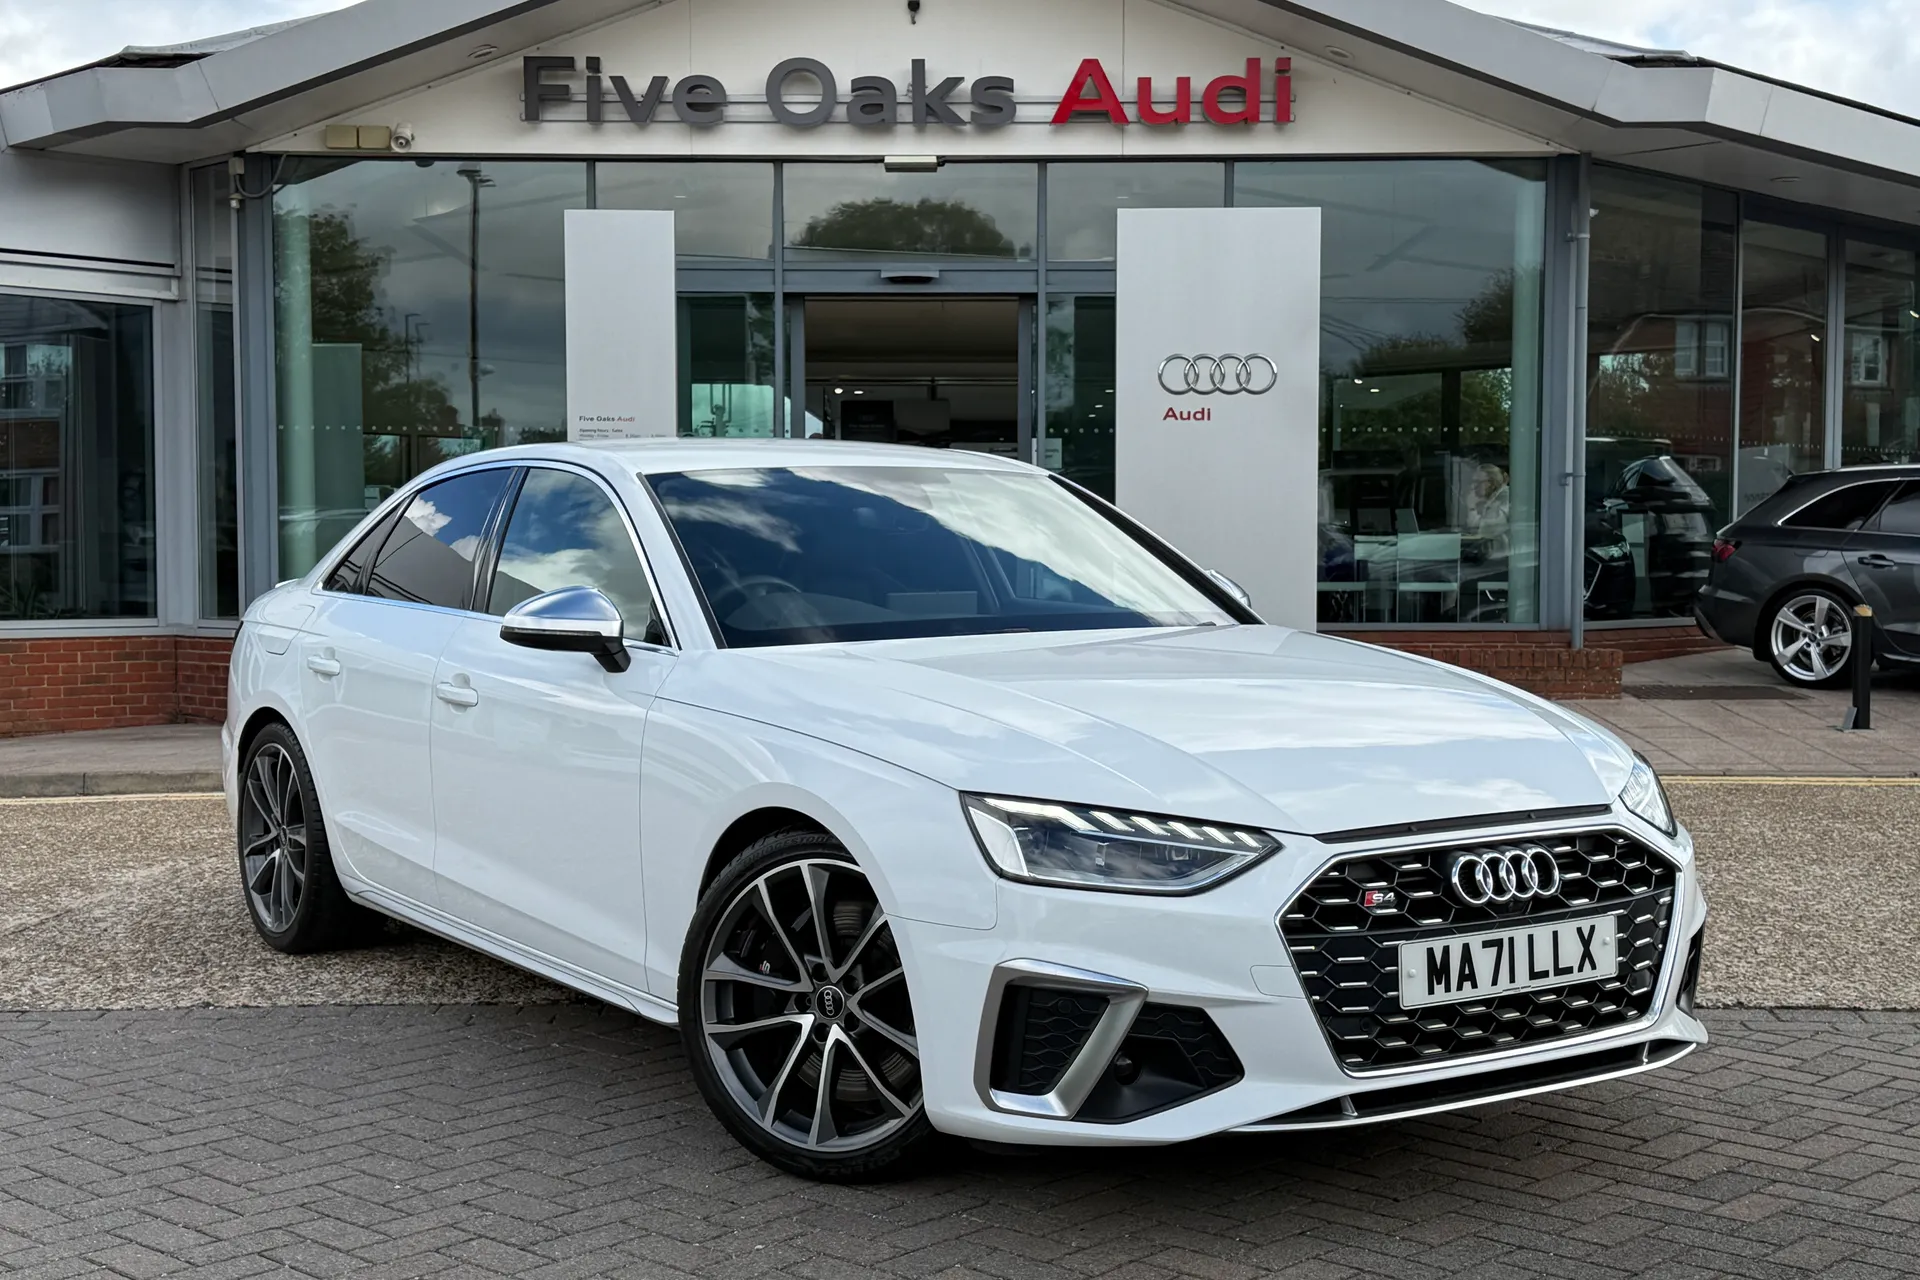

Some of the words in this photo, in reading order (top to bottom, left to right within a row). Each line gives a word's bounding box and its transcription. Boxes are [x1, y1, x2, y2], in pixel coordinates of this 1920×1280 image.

[522, 56, 727, 125] Five
[765, 57, 1017, 127] Oaks
[1050, 57, 1292, 125] Audi
[1163, 407, 1211, 422] Audi
